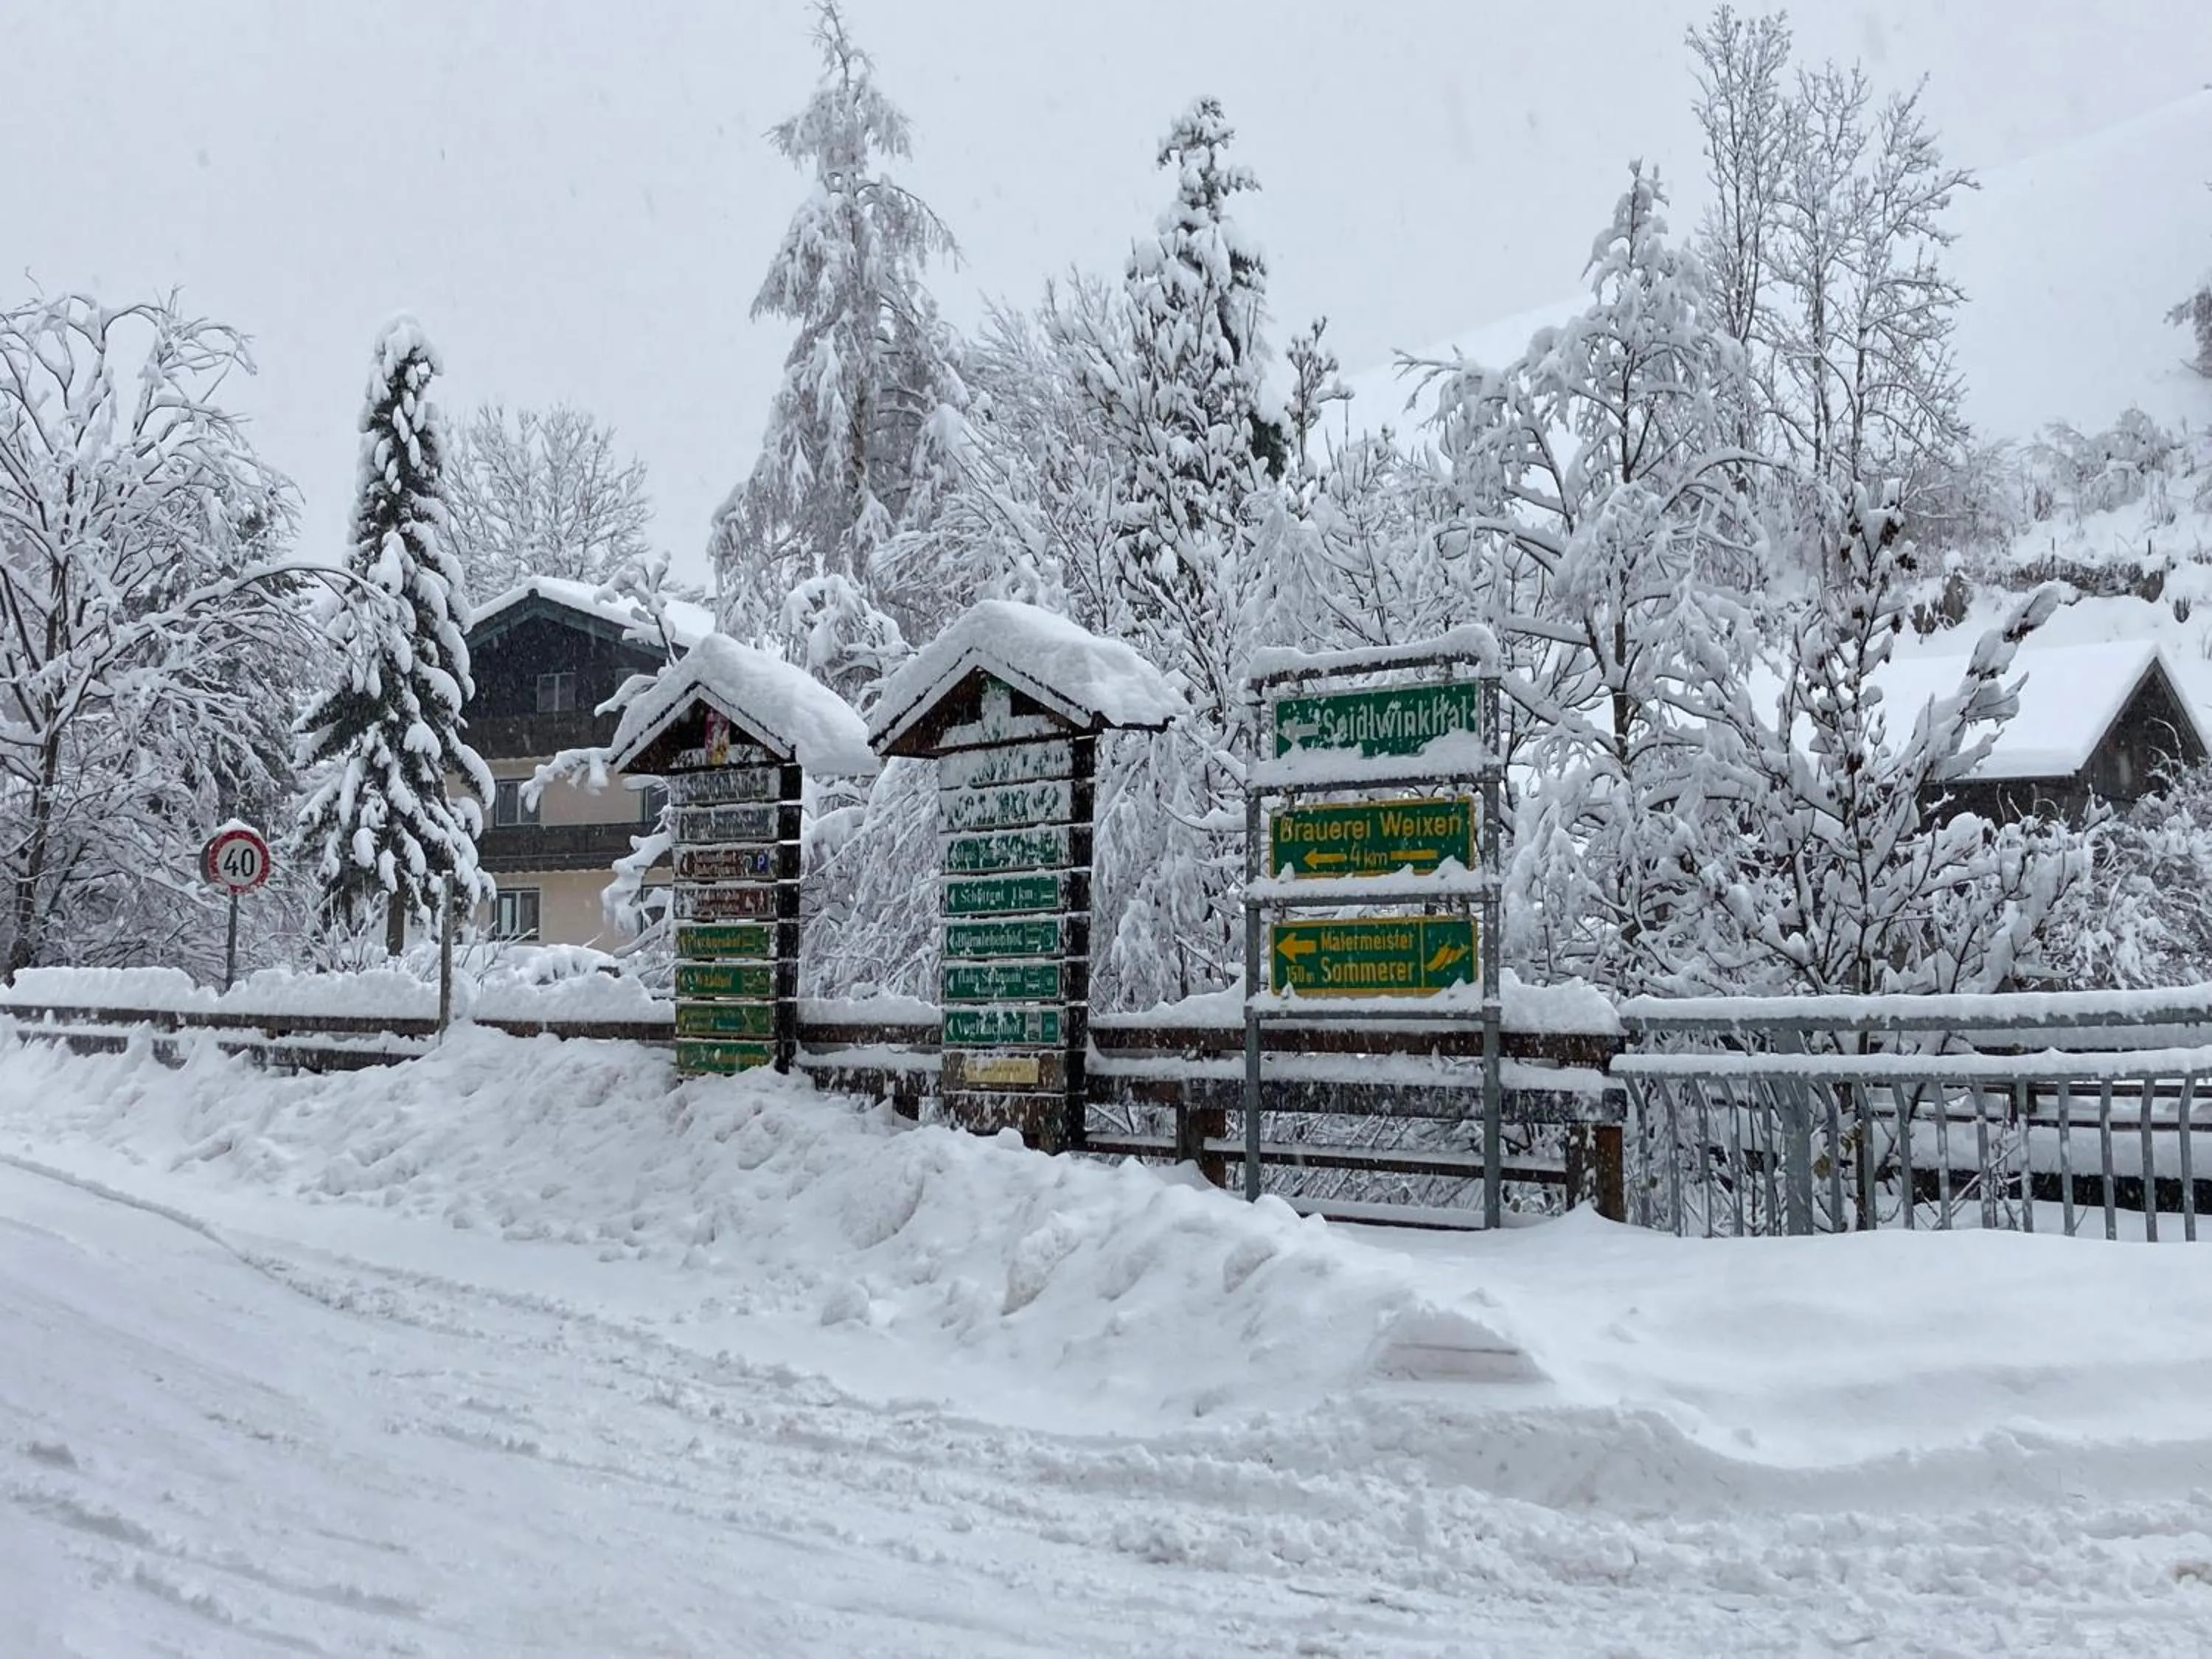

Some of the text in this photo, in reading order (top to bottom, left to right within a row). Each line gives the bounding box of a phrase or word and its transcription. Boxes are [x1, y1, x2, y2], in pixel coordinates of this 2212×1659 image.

[1279, 810, 1462, 843] Brauerei Weixen
[223, 848, 254, 877] 40
[1349, 841, 1387, 866] 4 km
[1321, 931, 1413, 952] Malermeister
[1321, 956, 1416, 983] Sommerer
